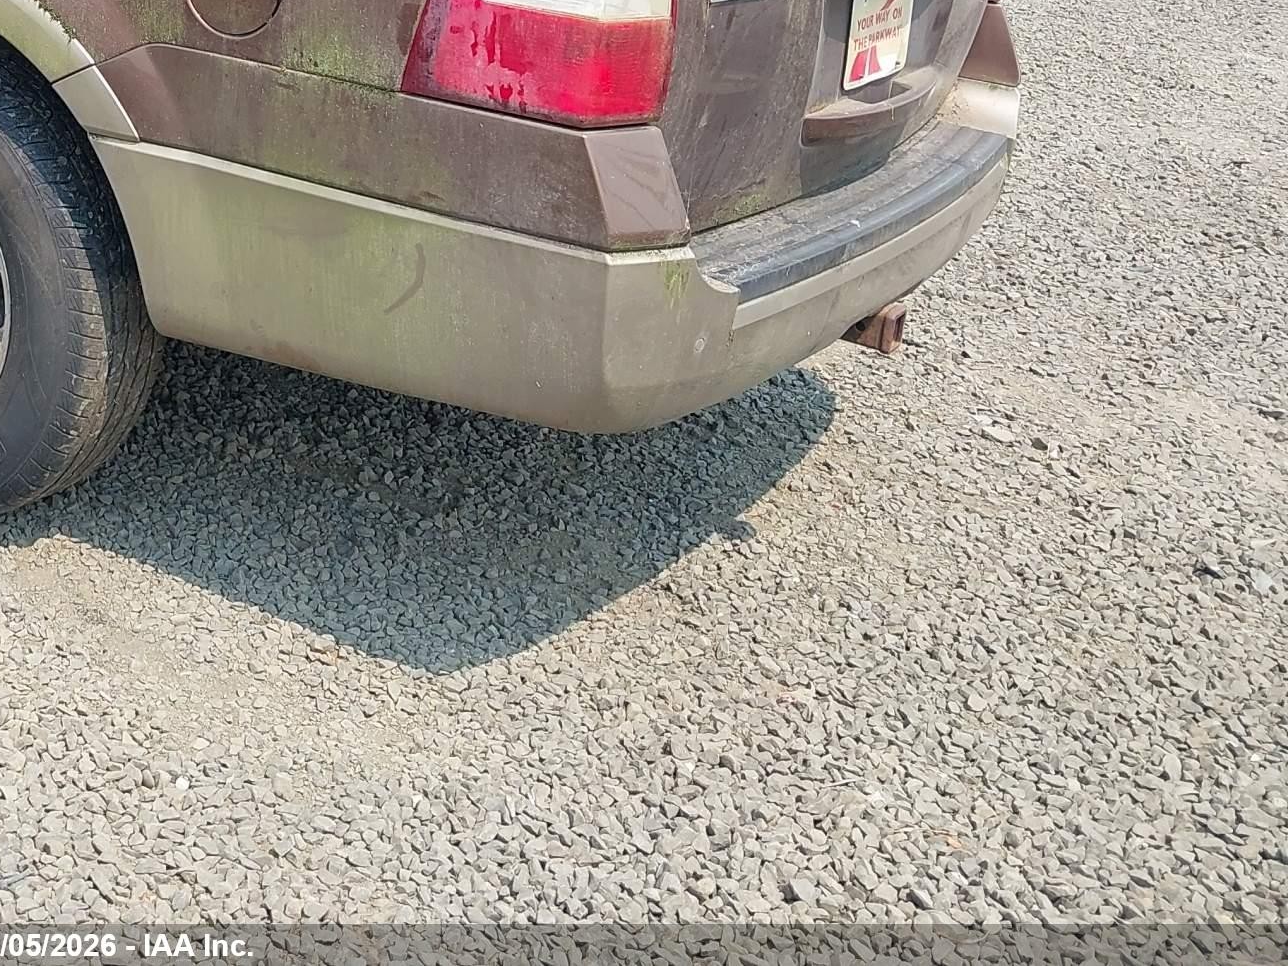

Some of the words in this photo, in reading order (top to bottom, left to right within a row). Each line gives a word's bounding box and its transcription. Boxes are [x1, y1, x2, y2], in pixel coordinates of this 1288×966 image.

[857, 14, 874, 32] YOUR
[875, 9, 891, 25] WAY
[892, 6, 903, 20] ON
[853, 37, 868, 51] THE
[868, 26, 901, 44] PARKWAY
